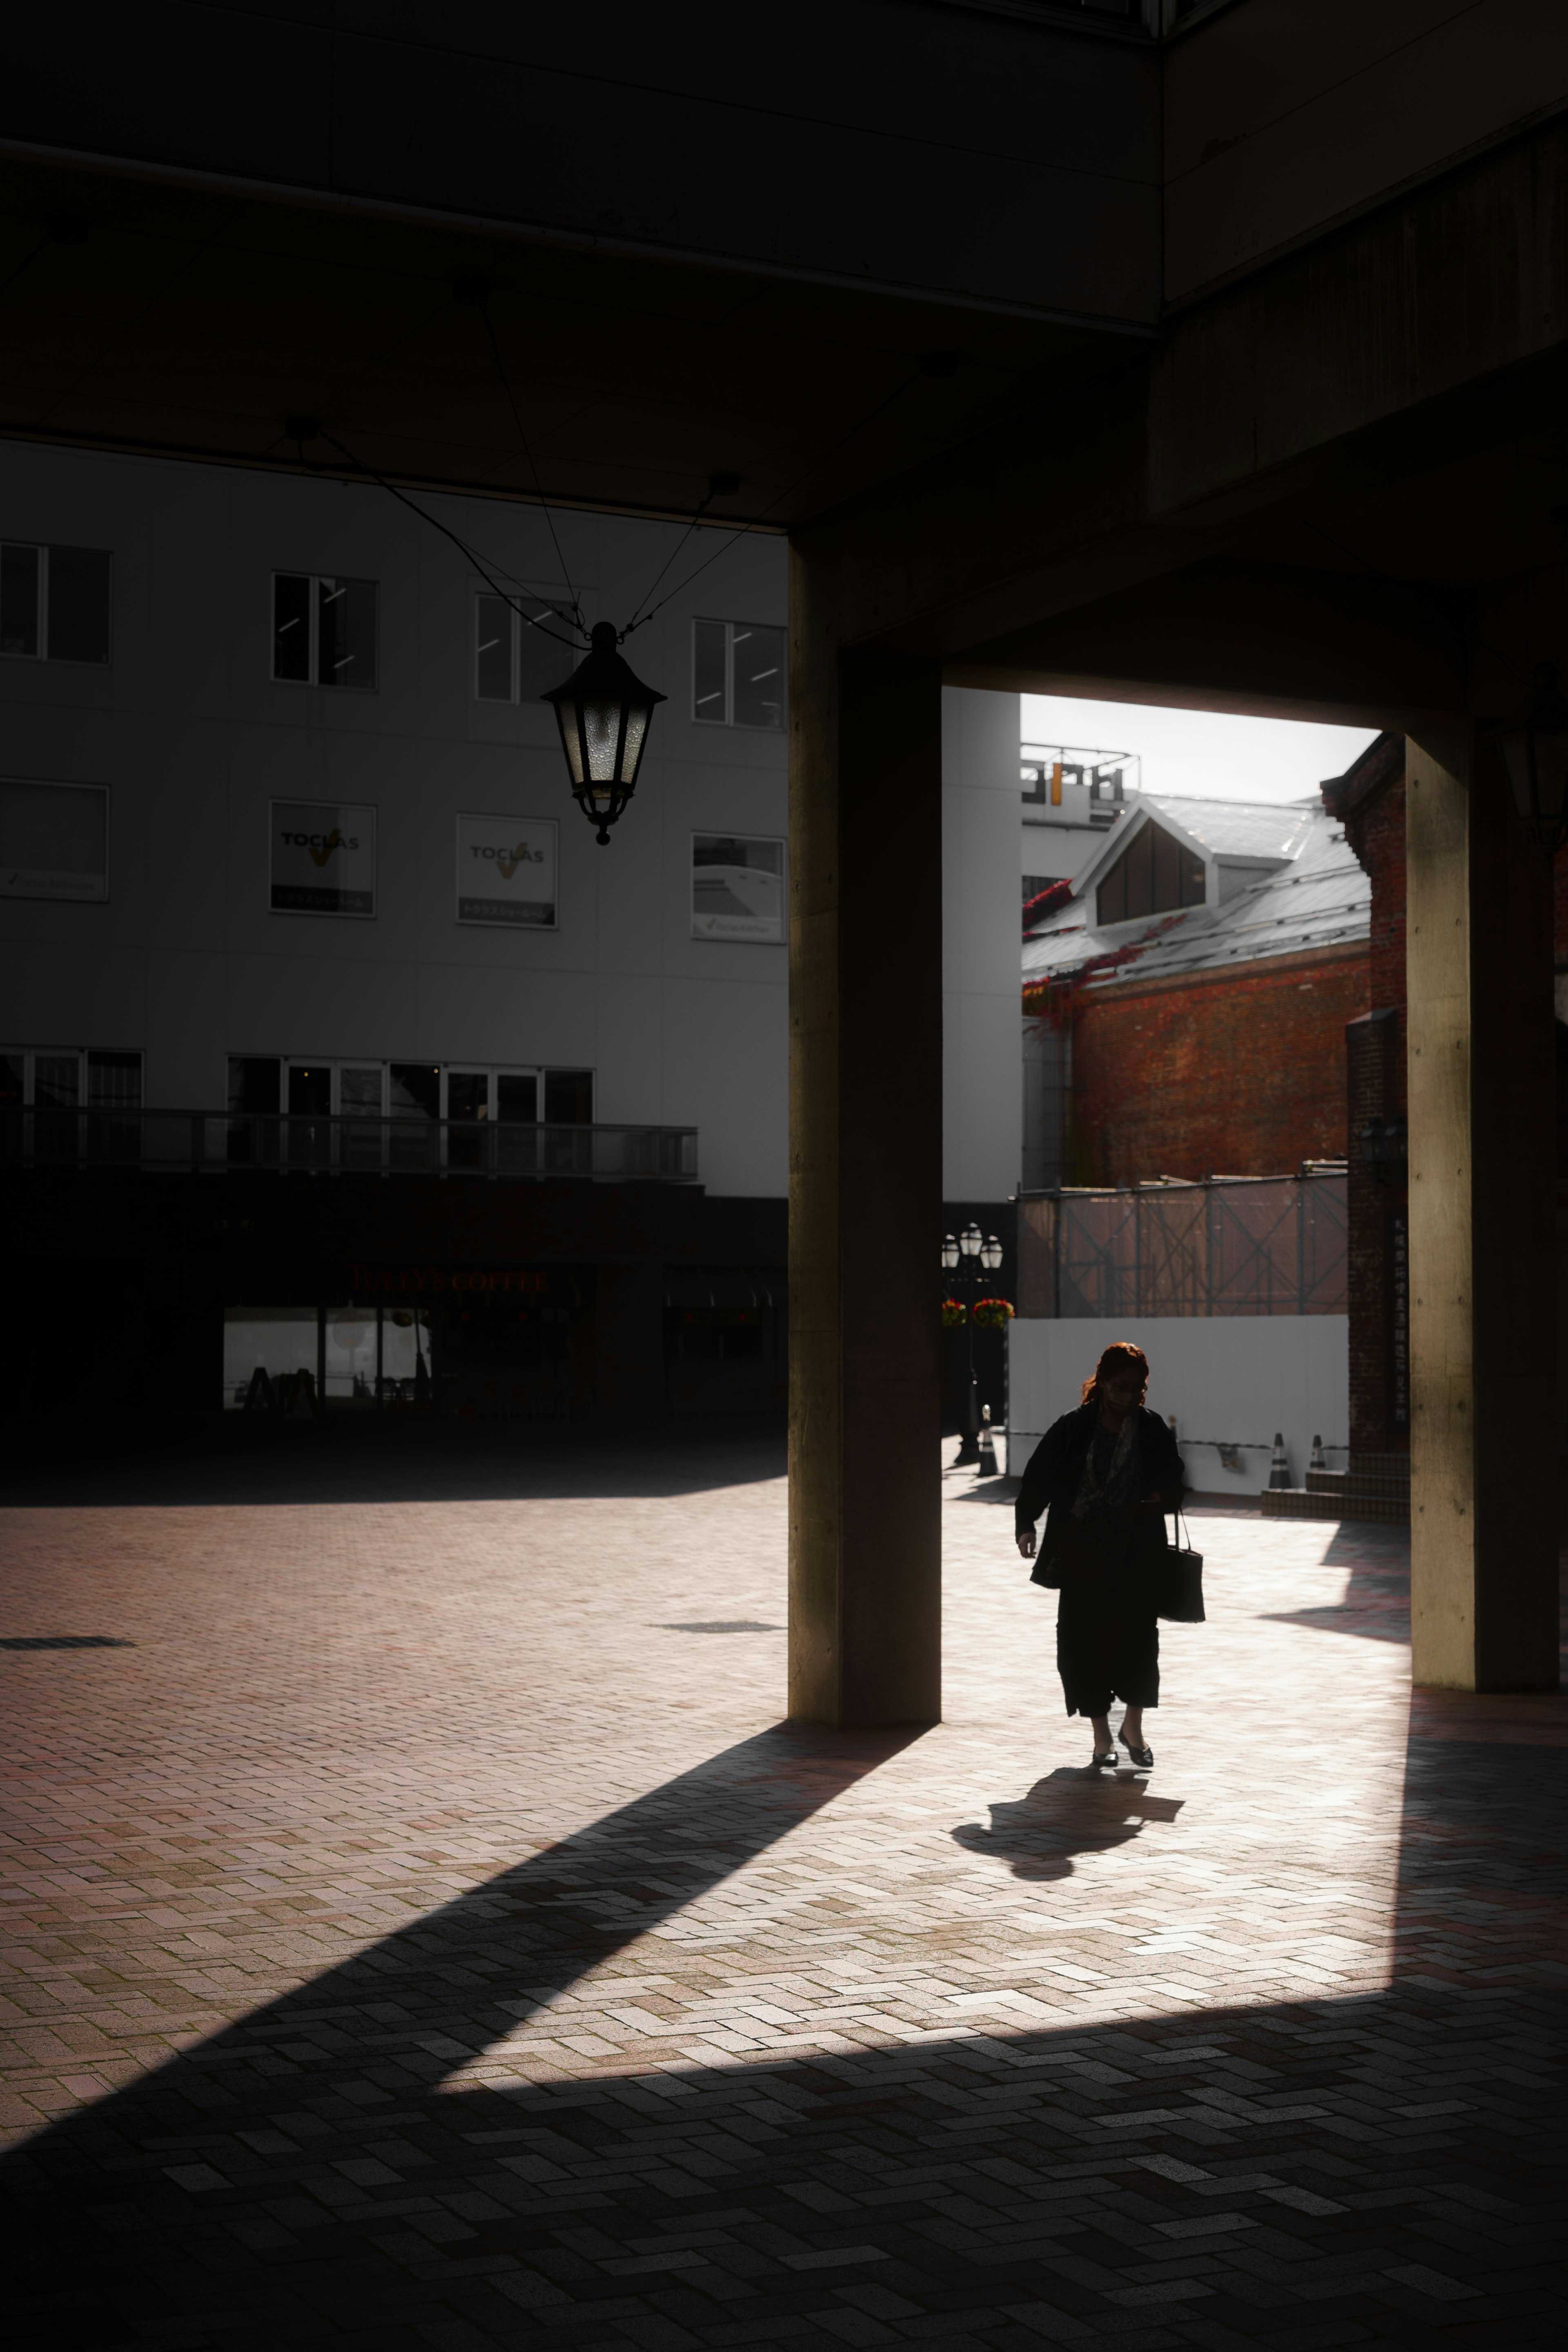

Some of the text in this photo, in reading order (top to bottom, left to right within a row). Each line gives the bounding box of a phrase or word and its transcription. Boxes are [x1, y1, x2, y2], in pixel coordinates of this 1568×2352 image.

[281, 832, 359, 849] TOCLAS
[470, 846, 544, 862] TOCLAS
[278, 893, 363, 907] トクラスショールーム
[464, 904, 546, 918] トクラスショールーム
